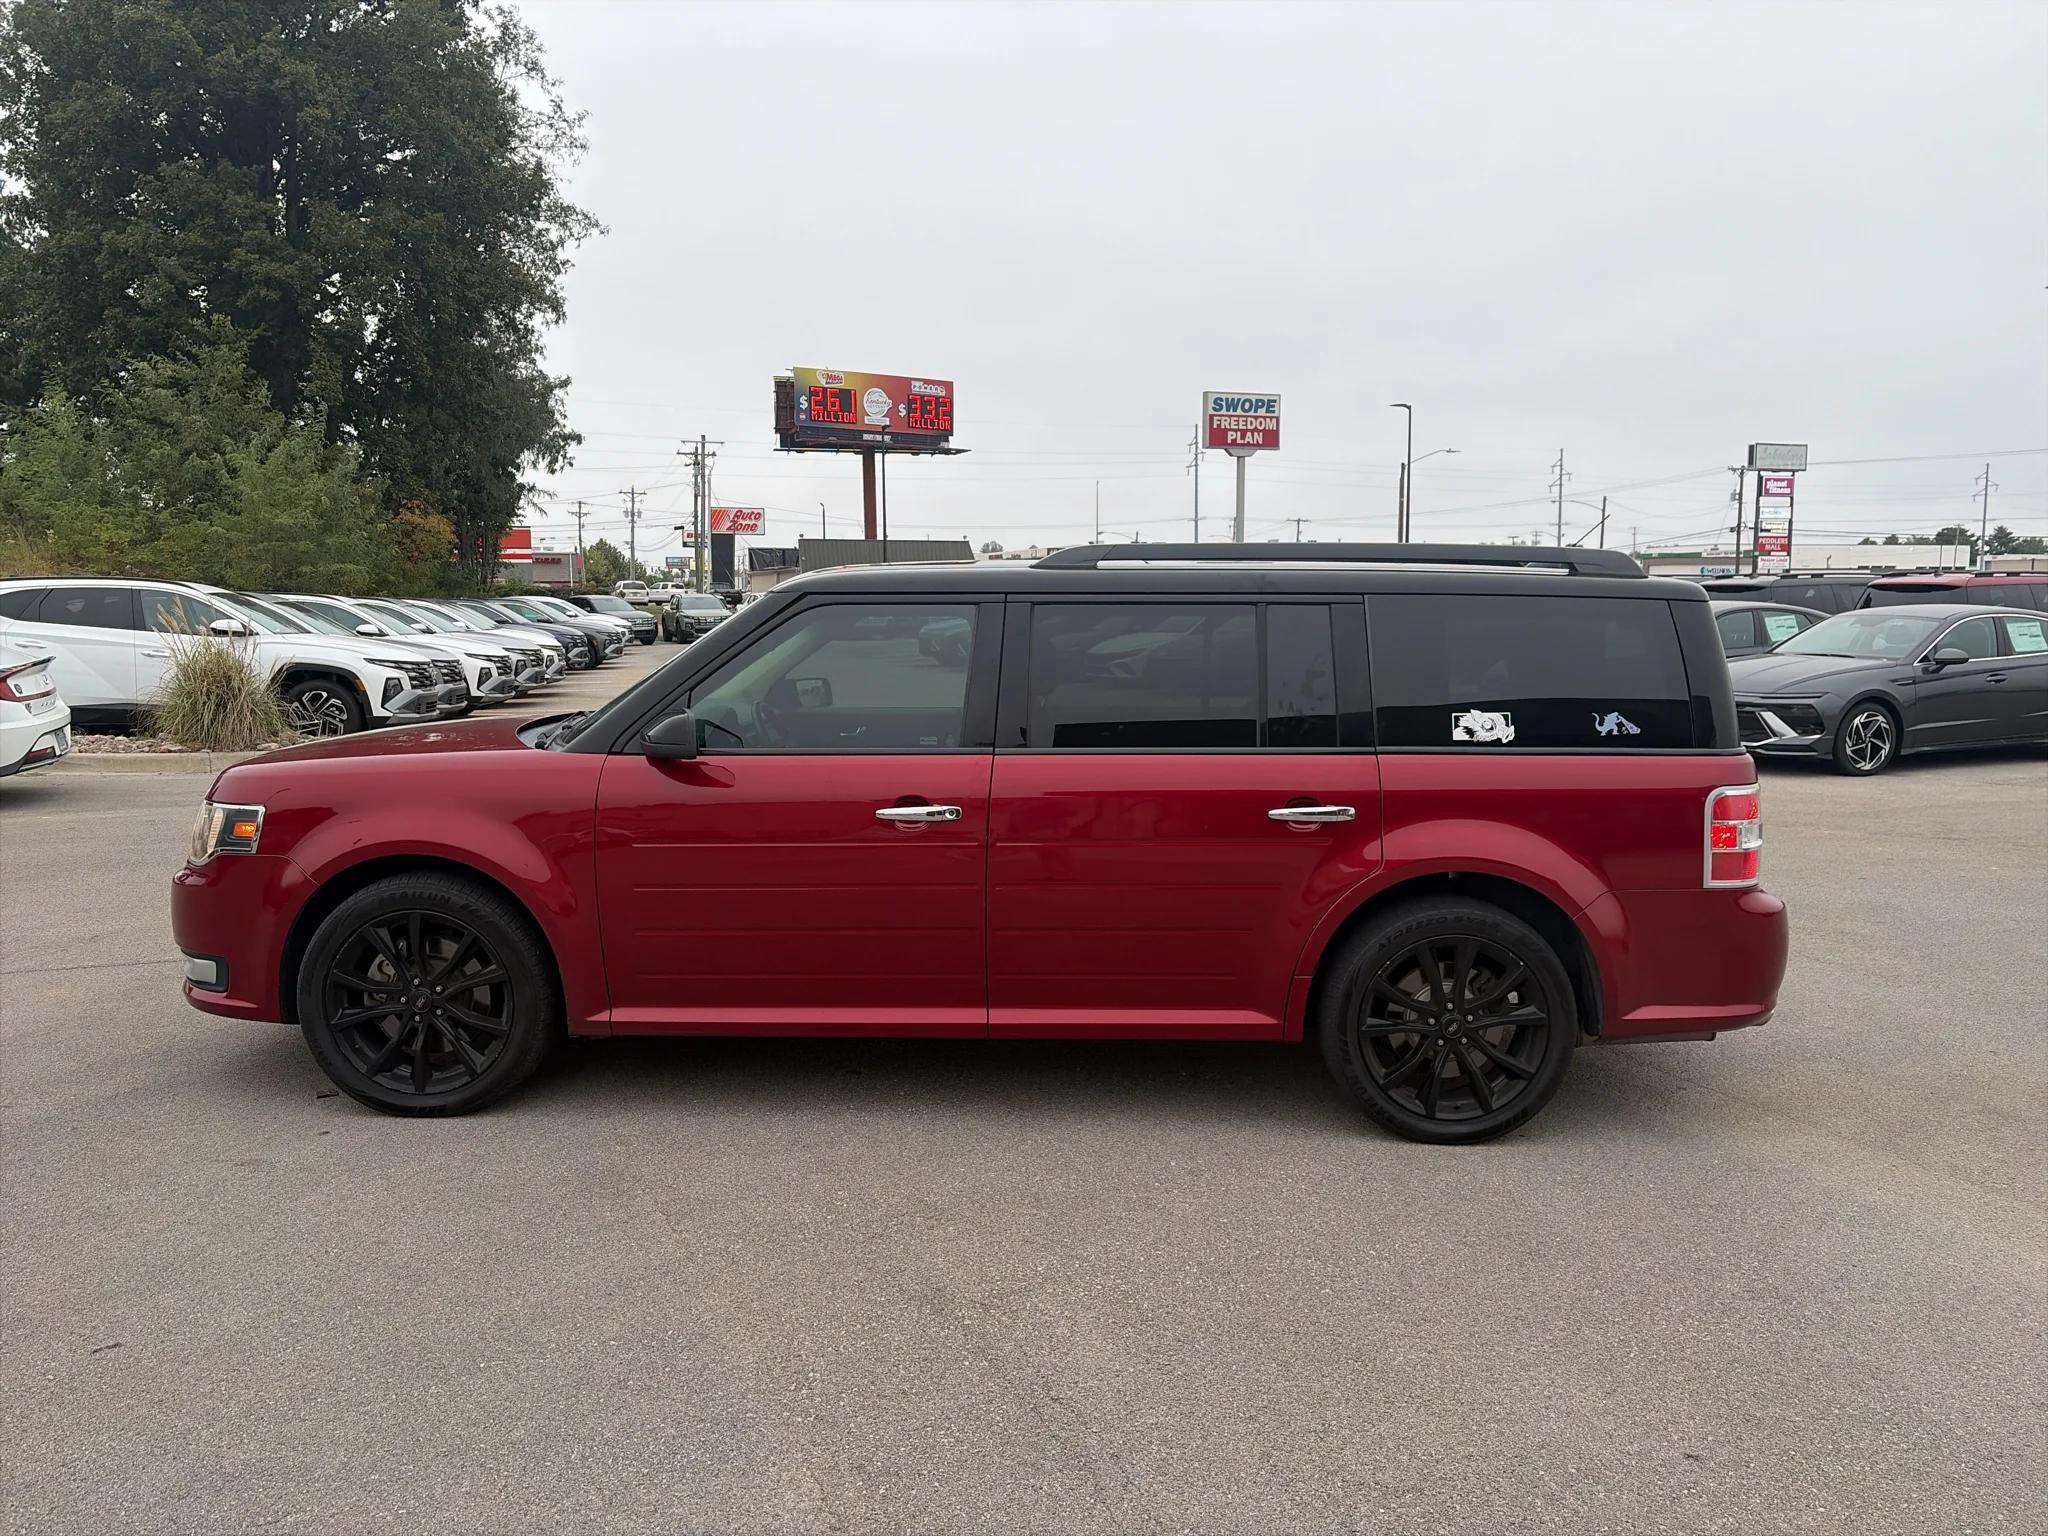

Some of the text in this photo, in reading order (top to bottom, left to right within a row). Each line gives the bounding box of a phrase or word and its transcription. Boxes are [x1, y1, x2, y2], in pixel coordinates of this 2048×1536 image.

[799, 386, 857, 412] $ 261
[865, 395, 892, 408] Kentucky
[1212, 396, 1278, 414] SWOPE
[897, 394, 952, 420] $ 332
[811, 410, 857, 423] MILLION
[909, 417, 951, 431] MILLION
[1213, 416, 1277, 431] FREEDOM
[1227, 431, 1264, 445] PLAN
[1766, 479, 1788, 489] planet
[1768, 486, 1791, 494] fitness
[731, 509, 762, 522] Auto
[726, 520, 759, 532] Zone
[1758, 537, 1789, 545] PEDDLERS
[1764, 543, 1782, 551] MALL
